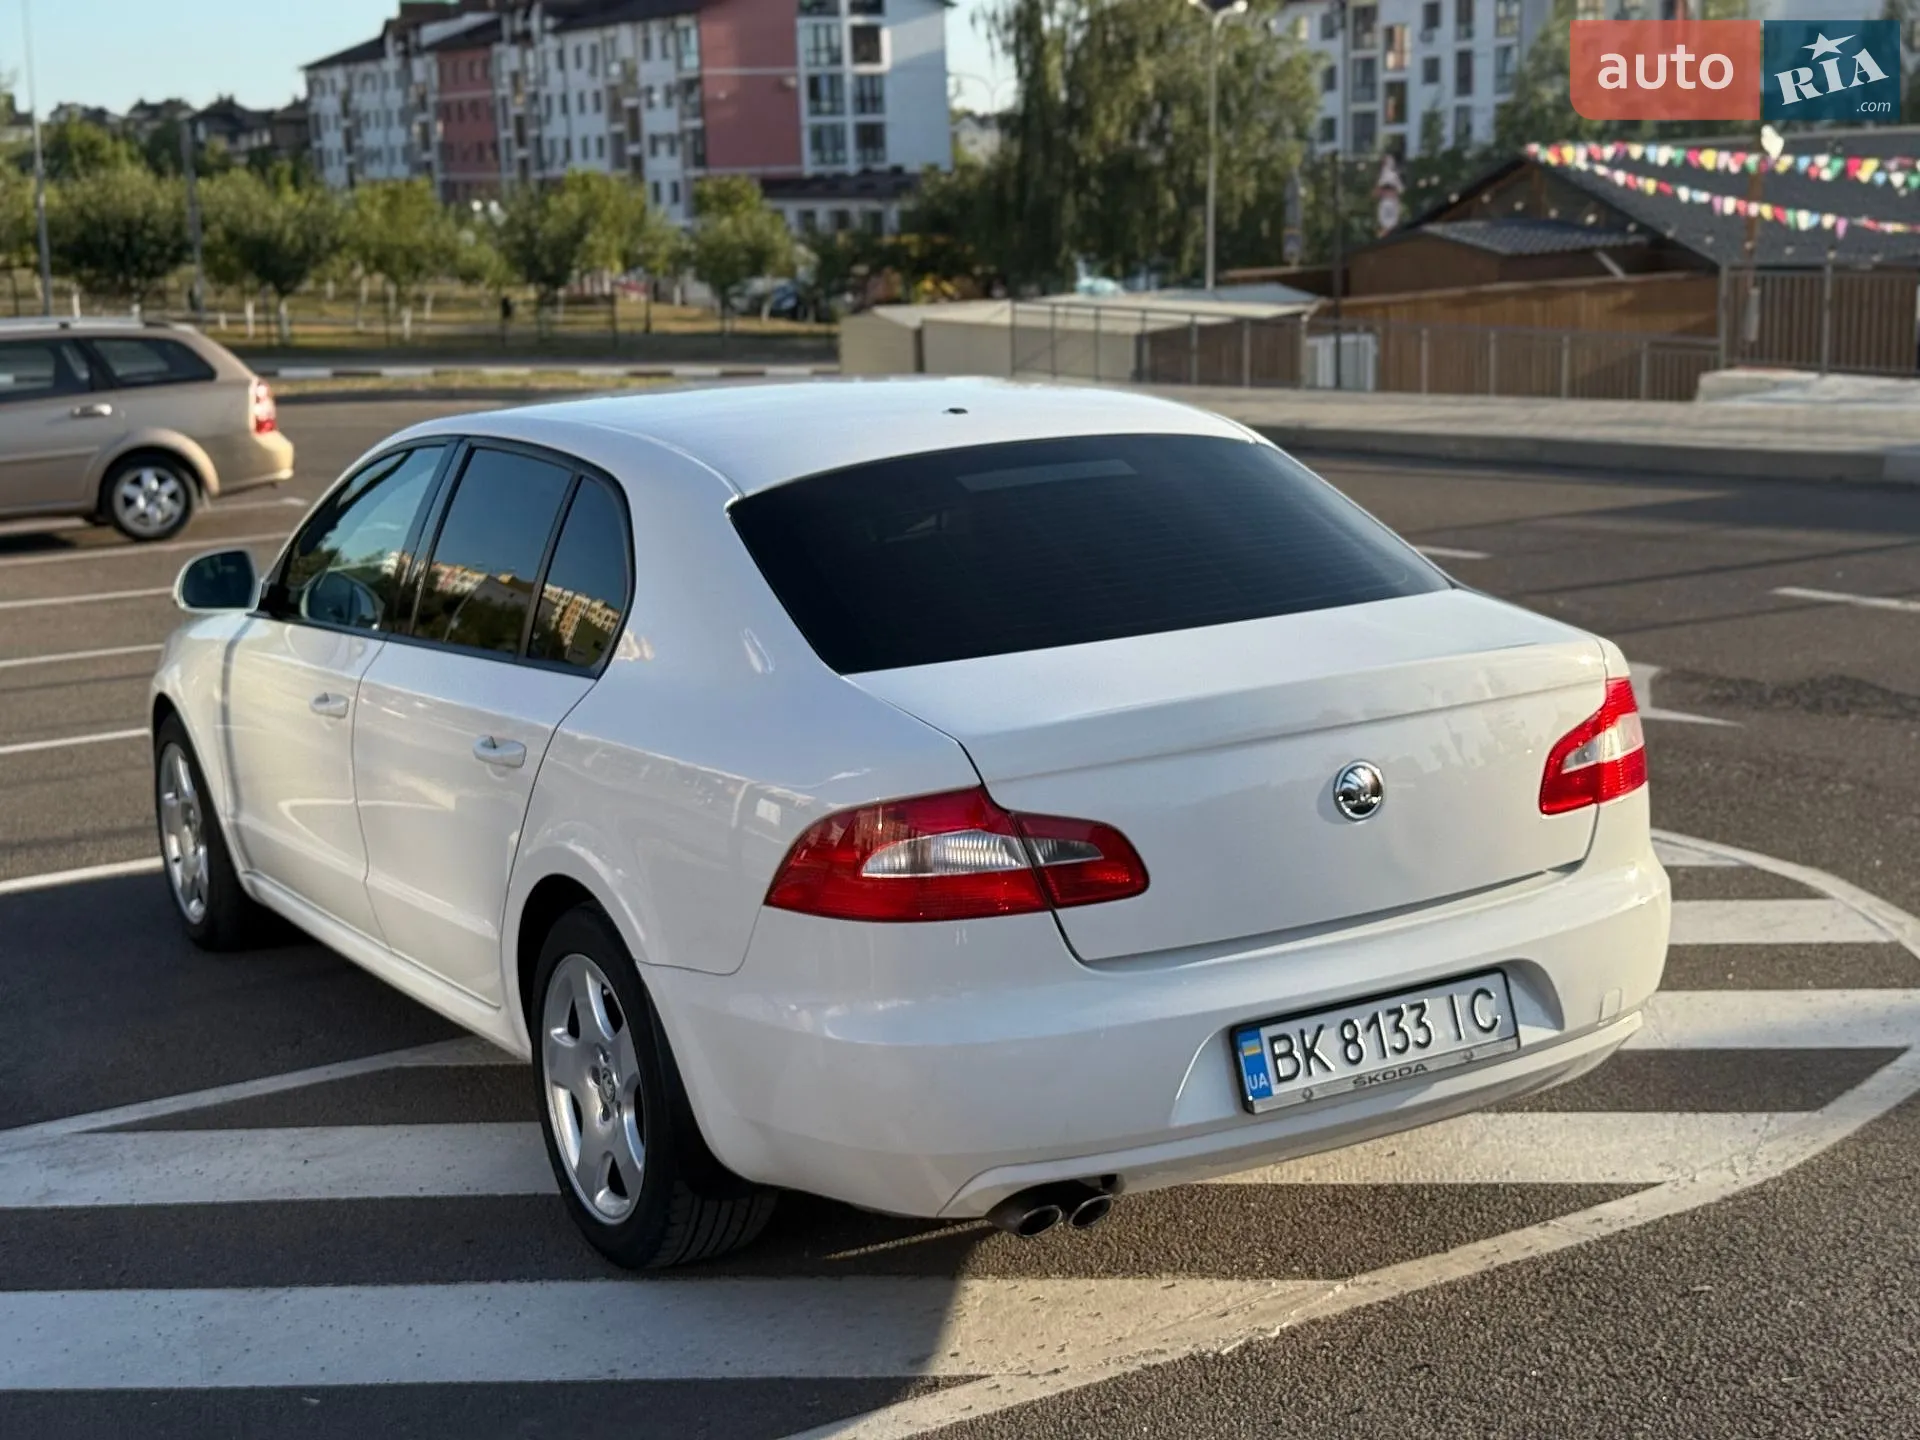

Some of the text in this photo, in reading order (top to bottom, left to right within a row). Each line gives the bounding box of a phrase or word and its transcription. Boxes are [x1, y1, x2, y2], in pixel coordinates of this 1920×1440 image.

[1269, 987, 1502, 1084] BK 8133 IC
[1249, 1073, 1269, 1091] UA
